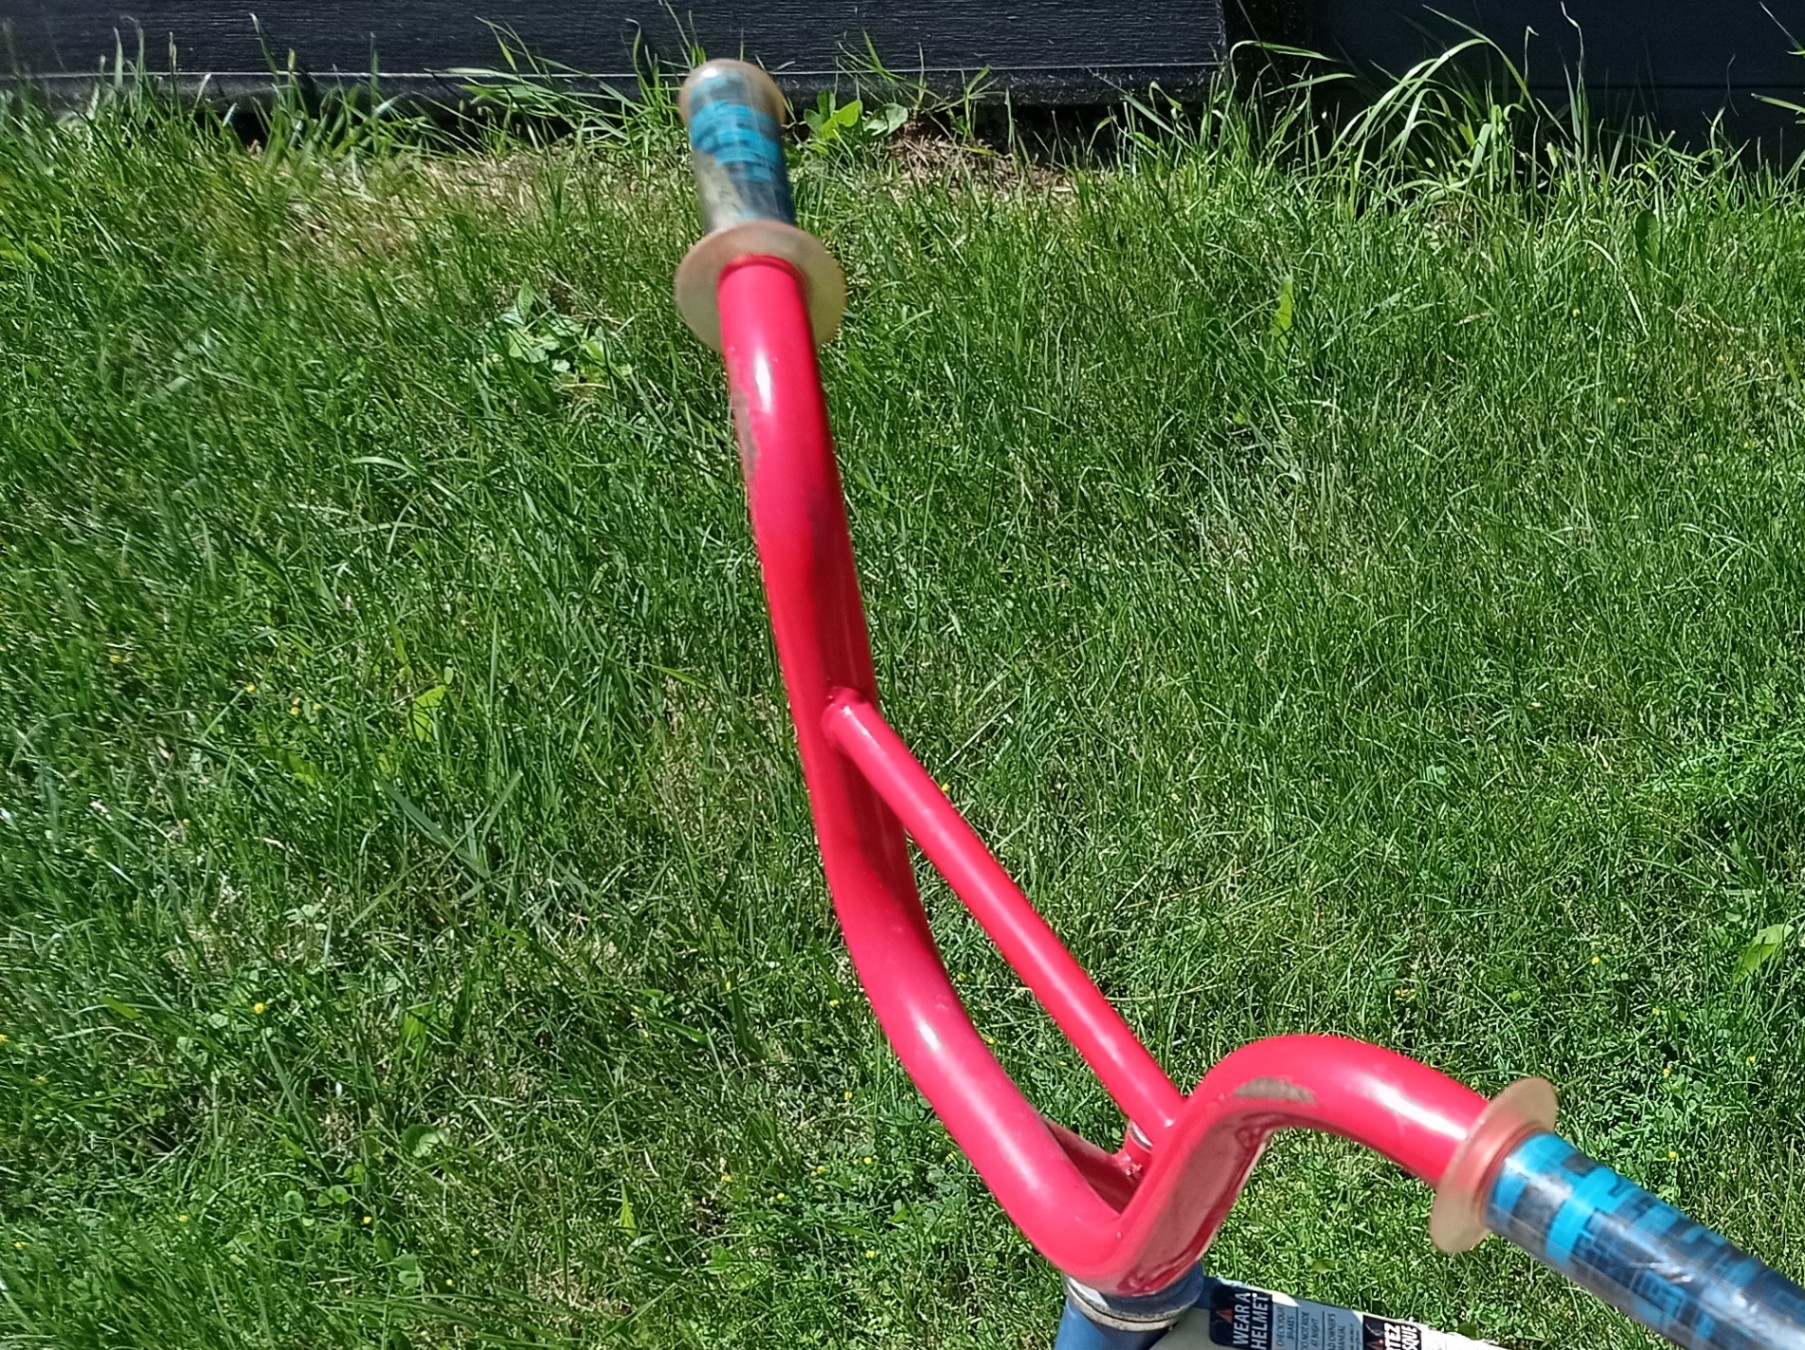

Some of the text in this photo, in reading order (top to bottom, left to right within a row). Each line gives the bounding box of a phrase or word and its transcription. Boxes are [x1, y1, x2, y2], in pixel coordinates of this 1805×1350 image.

[1232, 1292, 1251, 1345] WEAR A
[1250, 1296, 1269, 1350] HELMET
[1276, 1306, 1286, 1347] CHECK YOUR
[1286, 1315, 1295, 1340] BRAKES
[1301, 1311, 1310, 1326] RIDE
[1301, 1326, 1310, 1341] NOT
[1311, 1317, 1320, 1348] AT NIGHT
[1327, 1312, 1336, 1342] OWNER'S
